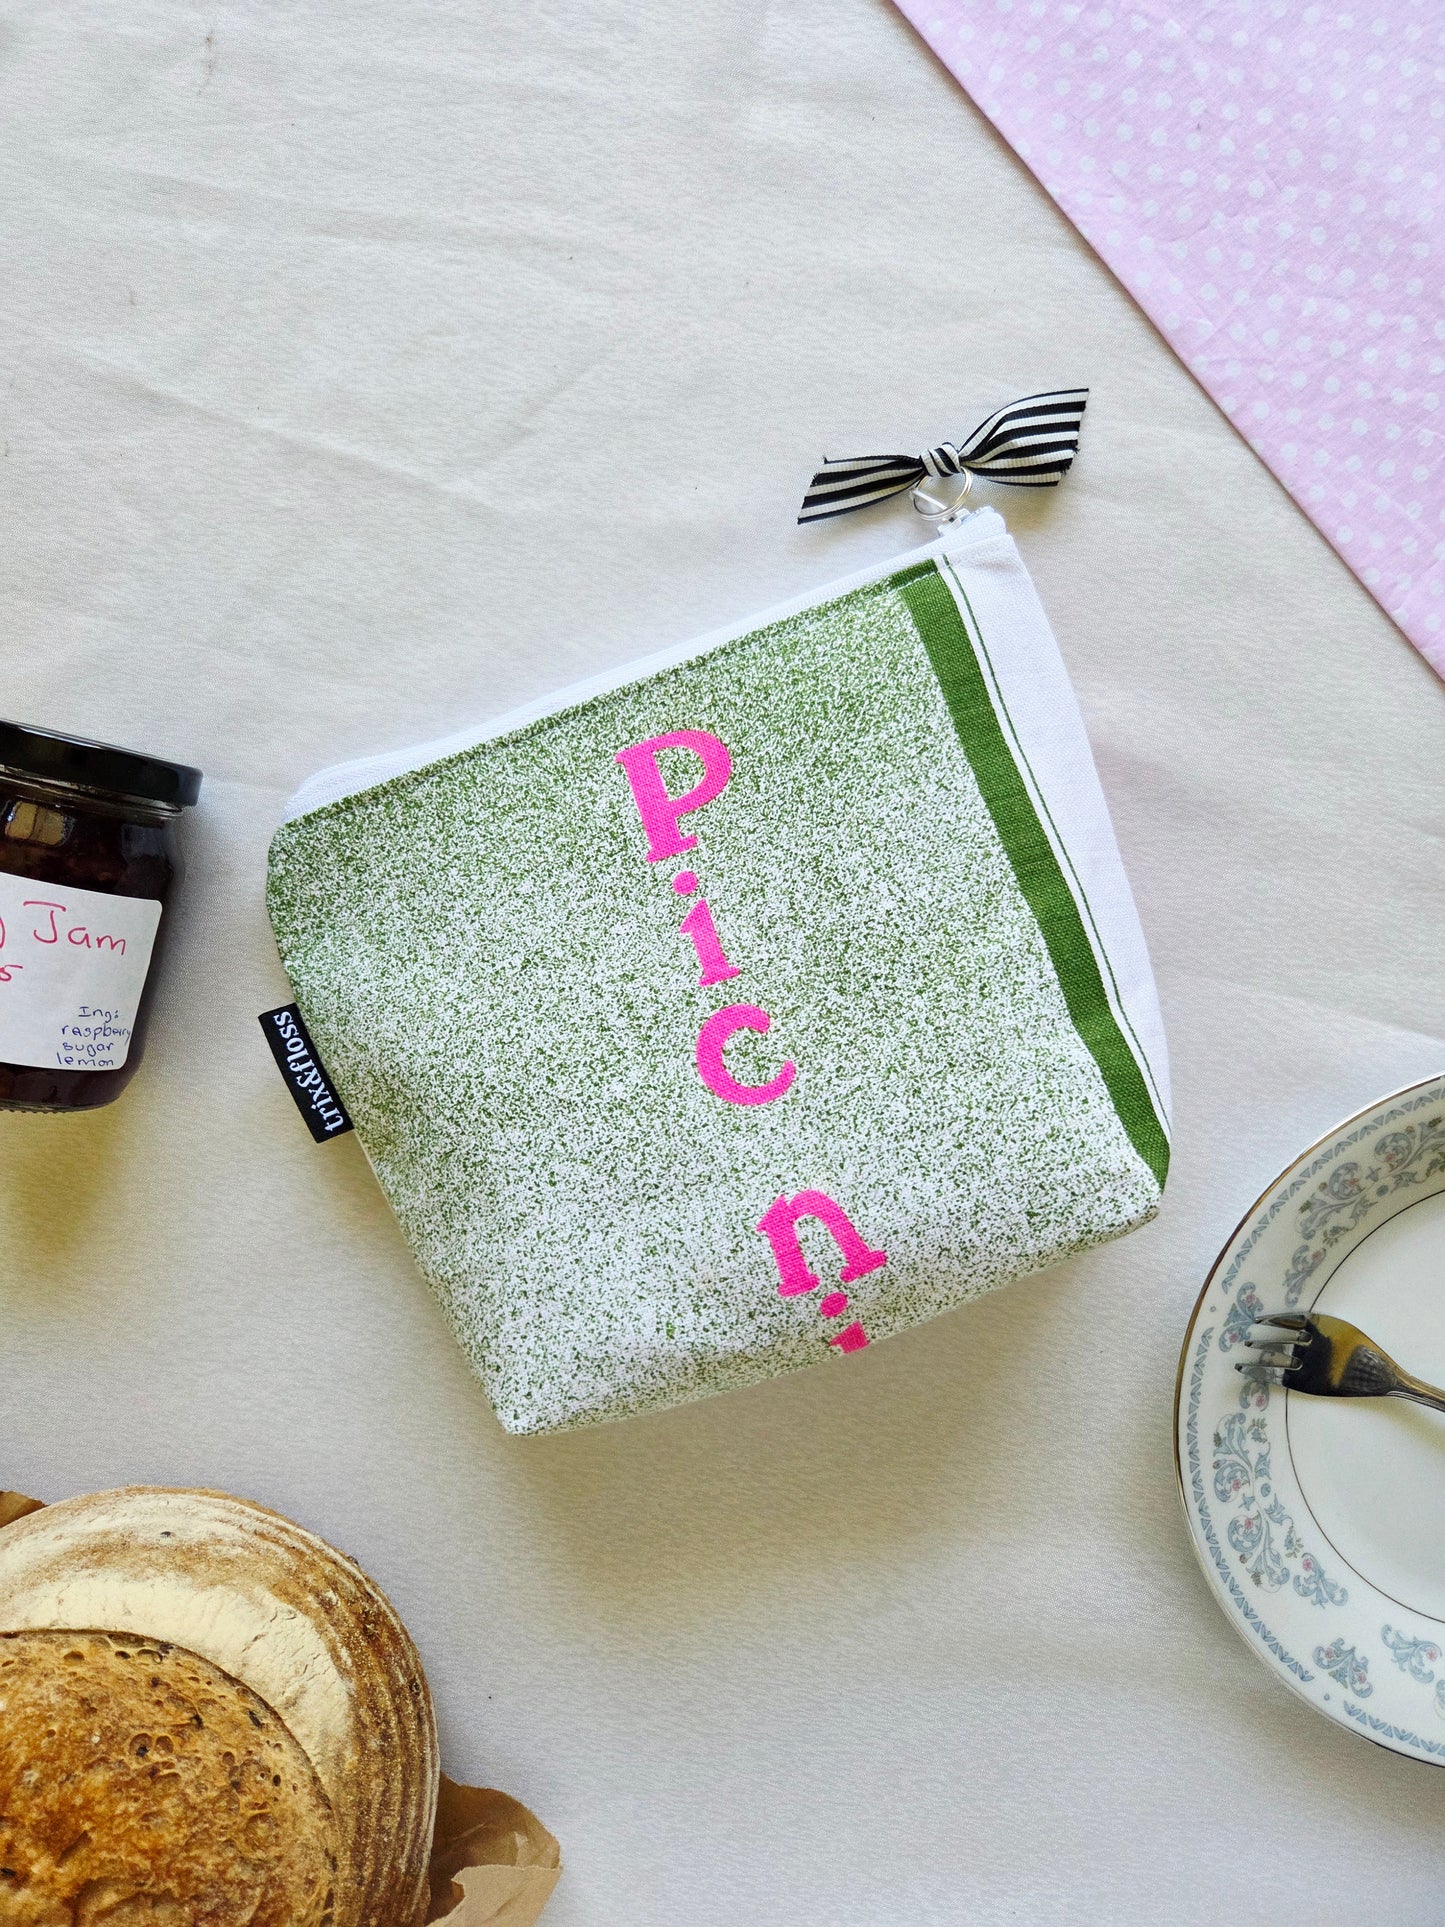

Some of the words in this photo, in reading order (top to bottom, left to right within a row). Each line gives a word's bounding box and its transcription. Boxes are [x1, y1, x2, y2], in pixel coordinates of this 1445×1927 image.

[23, 900, 126, 955] Jam
[56, 1052, 114, 1067] lemon
[62, 1042, 114, 1057] sugar
[274, 1011, 344, 1131] trix&floss
